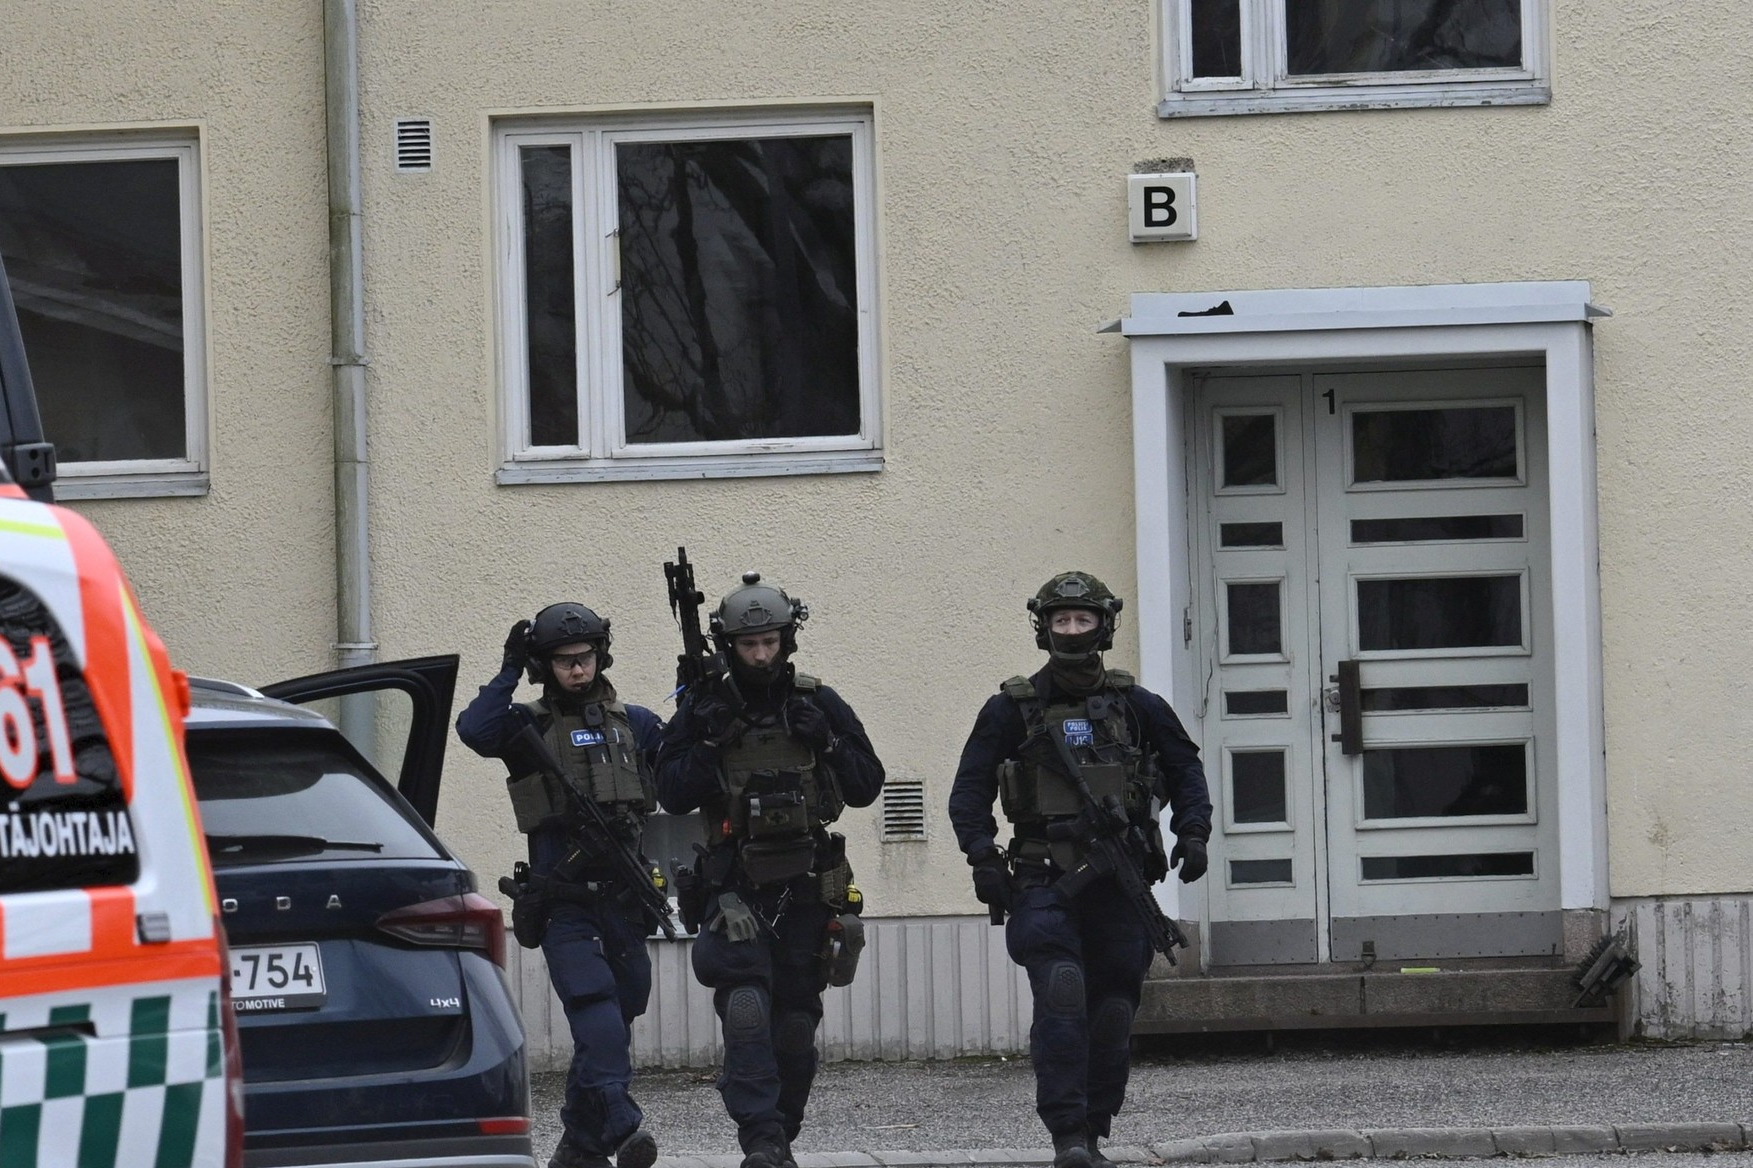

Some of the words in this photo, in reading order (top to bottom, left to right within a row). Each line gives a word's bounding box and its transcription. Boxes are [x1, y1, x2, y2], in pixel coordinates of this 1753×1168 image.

[1143, 186, 1177, 228] B
[1322, 388, 1335, 415] 1
[222, 894, 342, 913] ODA
[230, 952, 314, 990] -754
[231, 998, 286, 1011] TOMOTIVE
[430, 997, 460, 1008] 4x4
